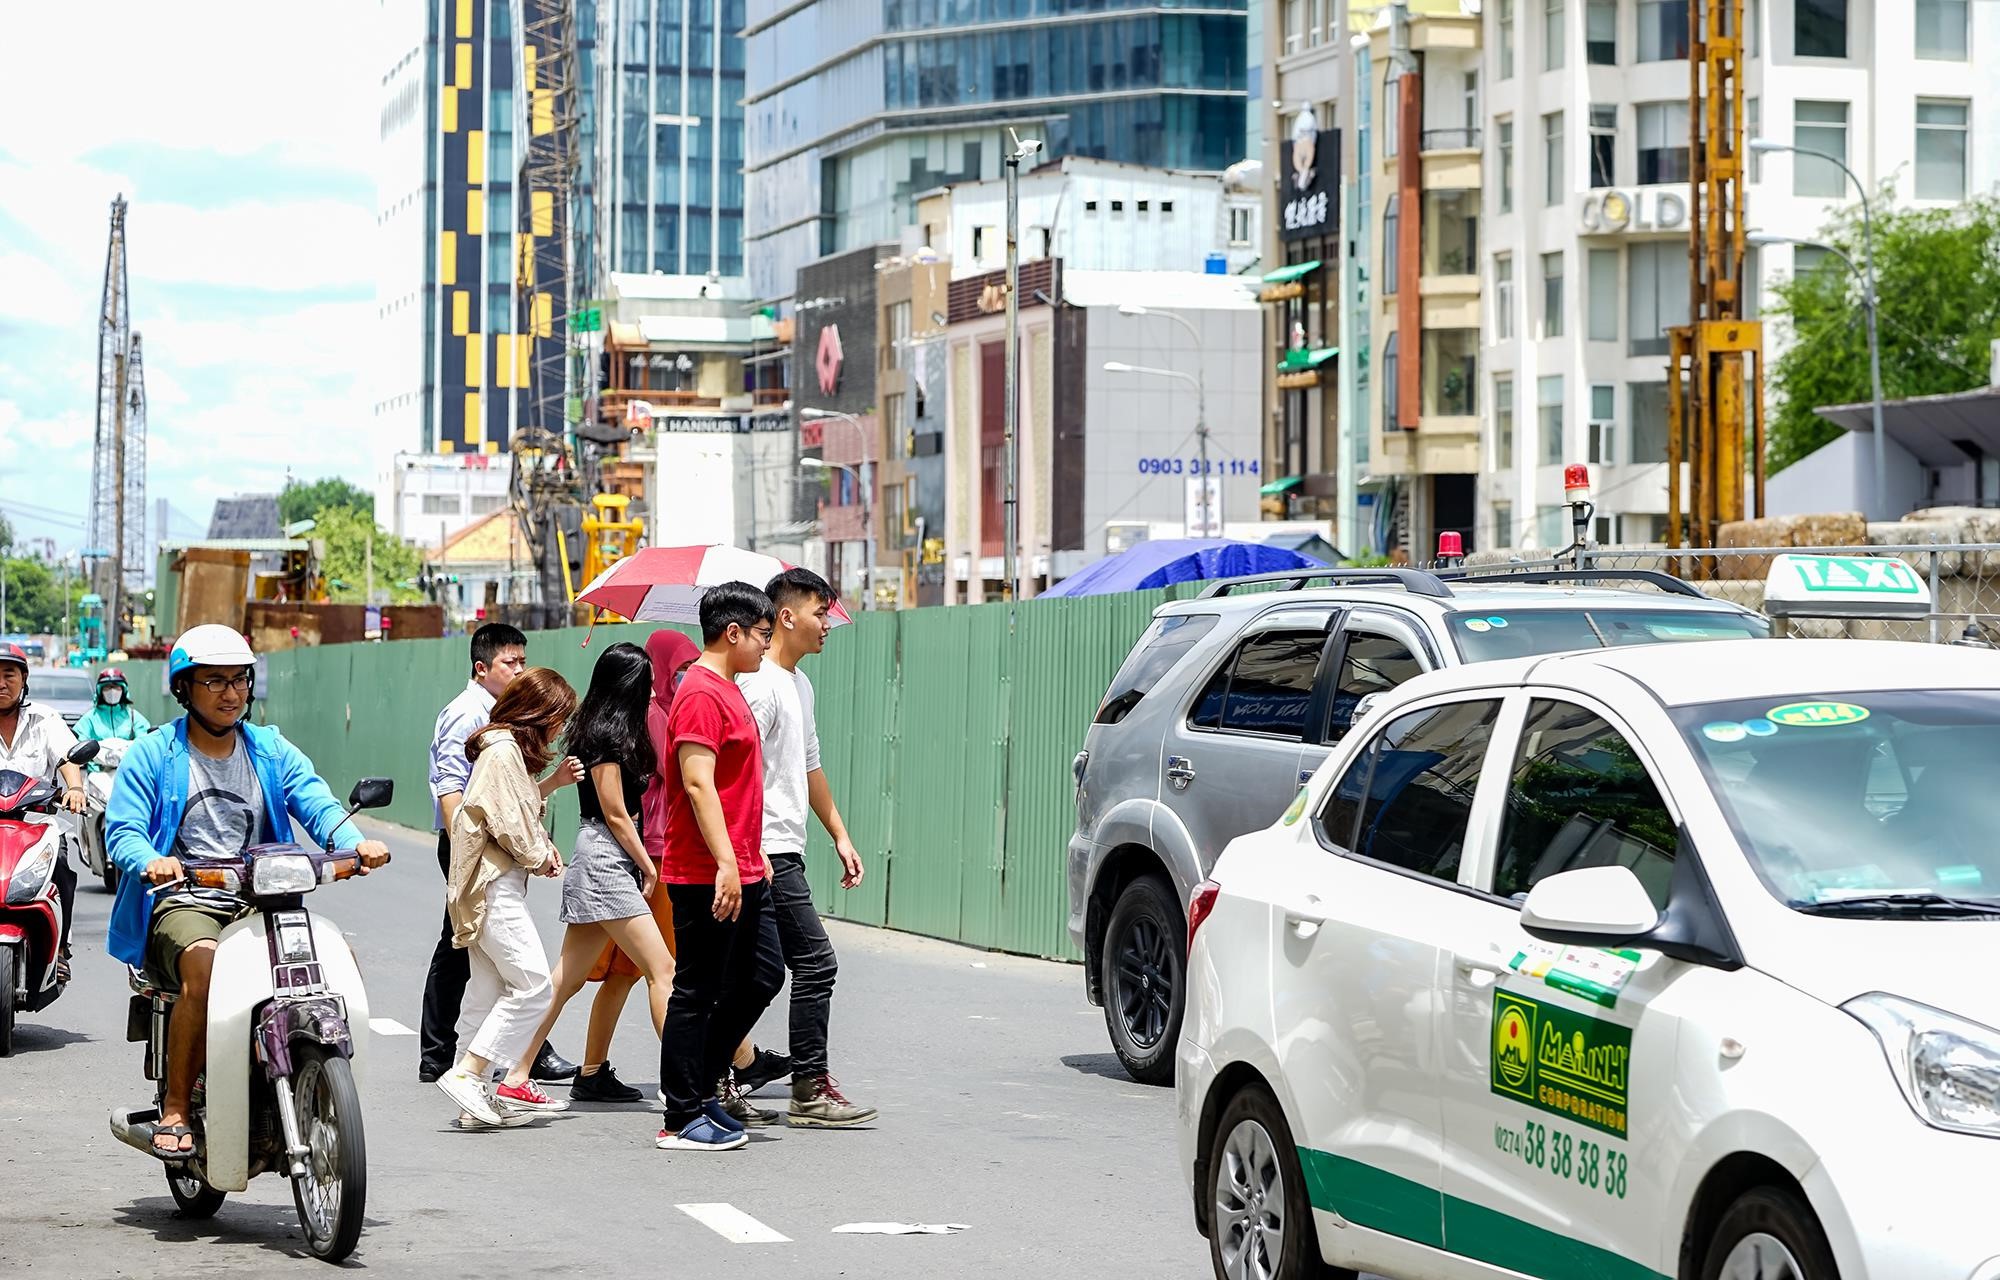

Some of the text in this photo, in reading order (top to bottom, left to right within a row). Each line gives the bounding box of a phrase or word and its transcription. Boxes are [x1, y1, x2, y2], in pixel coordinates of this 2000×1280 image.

[1139, 458, 1183, 475] 0903
[1539, 1084, 1625, 1132] CORPORATION
[1494, 1120, 1628, 1200] (0274) 38 38 38 38
